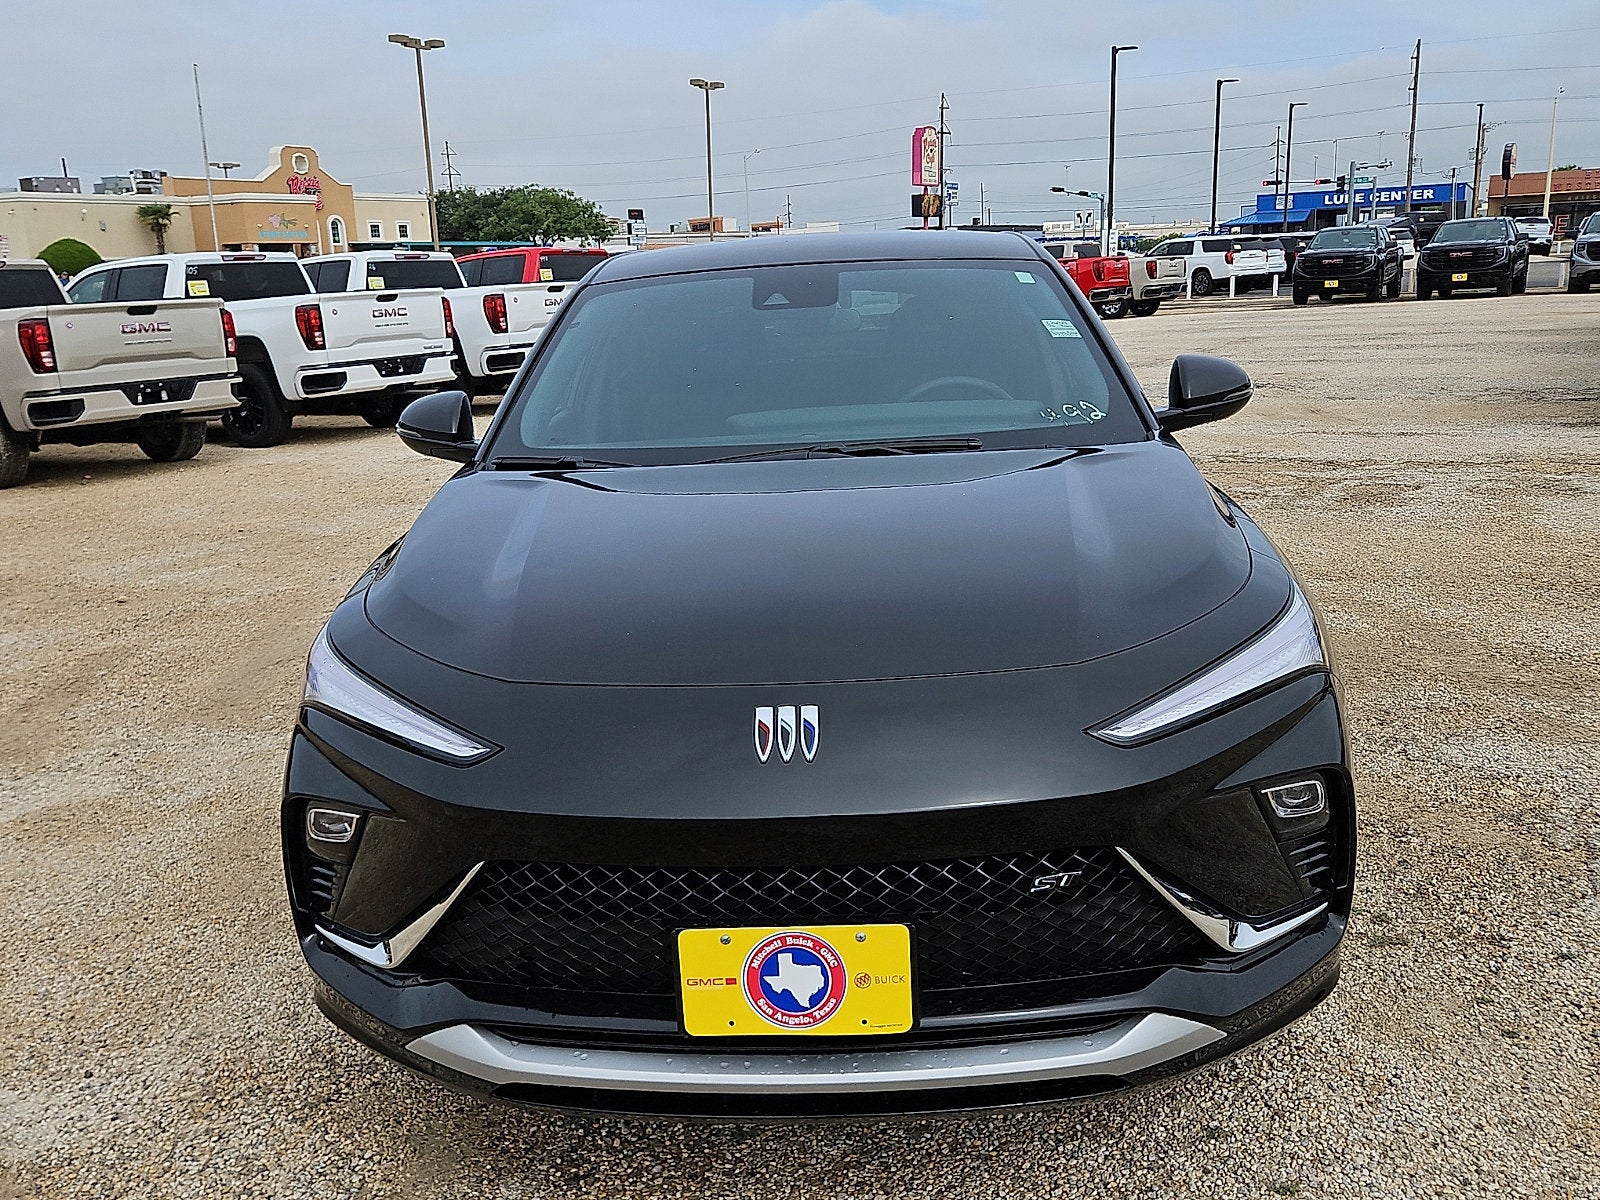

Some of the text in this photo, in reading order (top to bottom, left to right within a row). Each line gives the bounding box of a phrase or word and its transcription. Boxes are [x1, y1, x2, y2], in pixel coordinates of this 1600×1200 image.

[1369, 189, 1434, 201] CENTER
[544, 298, 564, 307] GM
[372, 307, 408, 318] GMC
[120, 321, 172, 334] GMC
[1030, 871, 1082, 892] ST
[751, 937, 838, 969] Mitchell Buick GMC
[686, 977, 725, 986] GMC
[874, 975, 905, 985] BUICK
[757, 998, 774, 1016] San
[812, 997, 837, 1019] Texas
